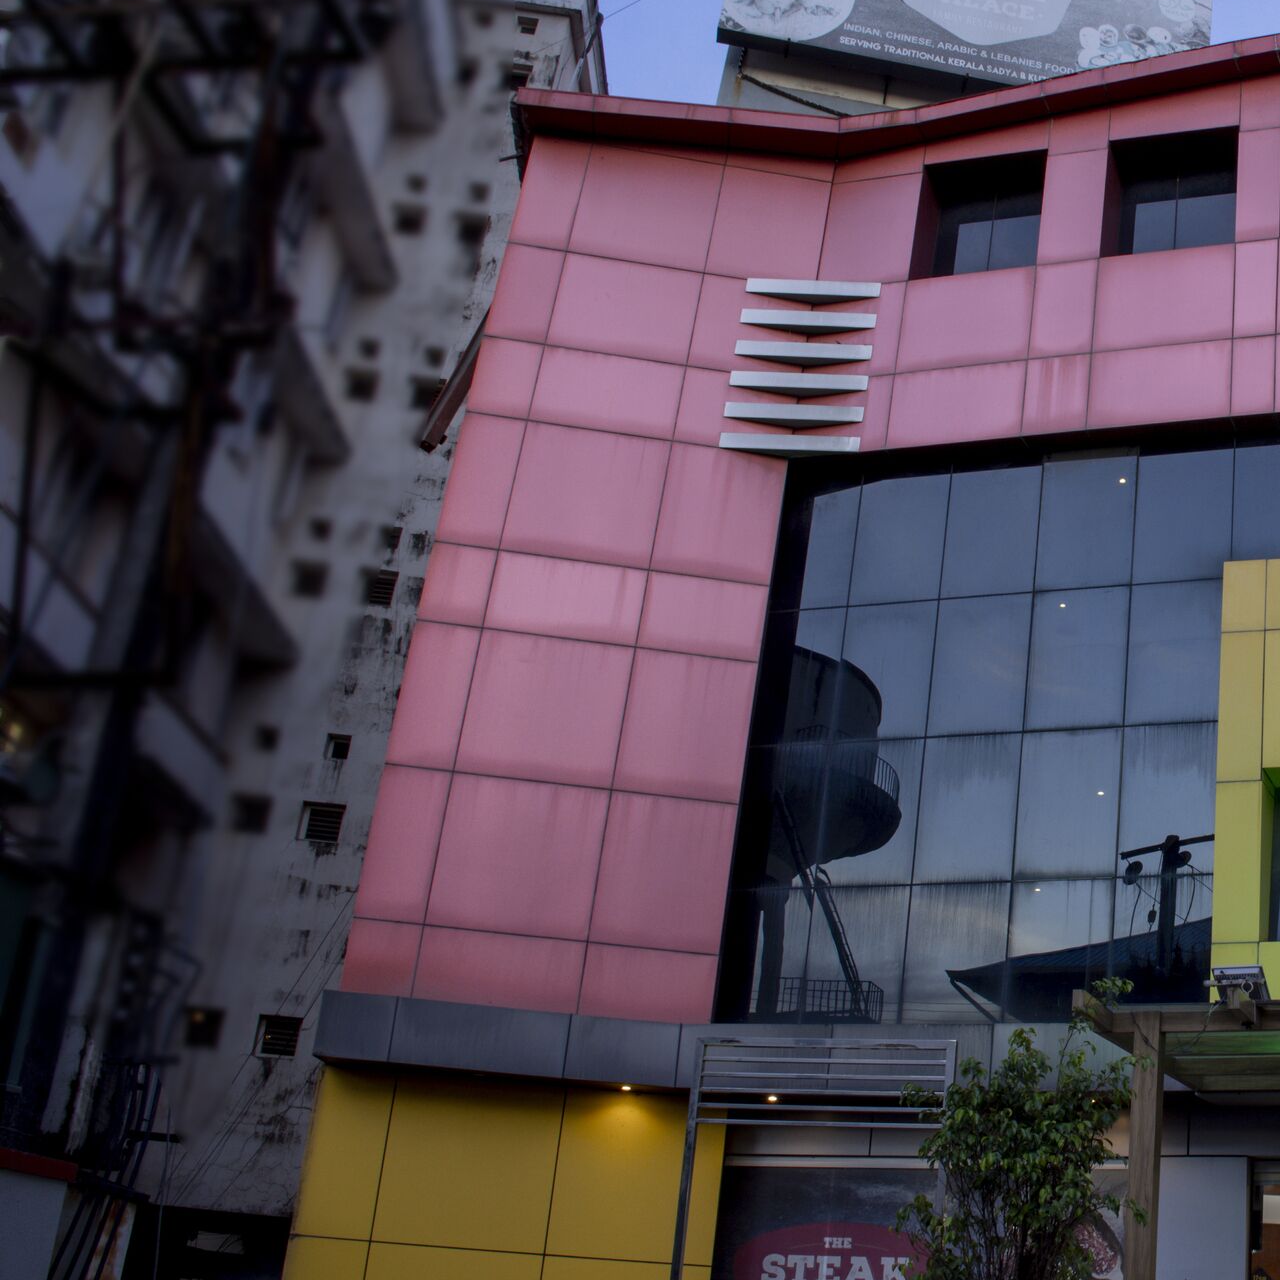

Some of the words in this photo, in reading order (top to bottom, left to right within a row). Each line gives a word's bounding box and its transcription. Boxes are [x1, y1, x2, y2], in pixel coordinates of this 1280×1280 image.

[839, 36, 881, 51] SERVING
[884, 44, 947, 64] TRADITIONAL
[948, 57, 985, 72] KERALA
[937, 42, 978, 57] ARABIC
[980, 50, 988, 58] &
[991, 52, 1042, 69] LEBANIES
[824, 1237, 853, 1249] THE
